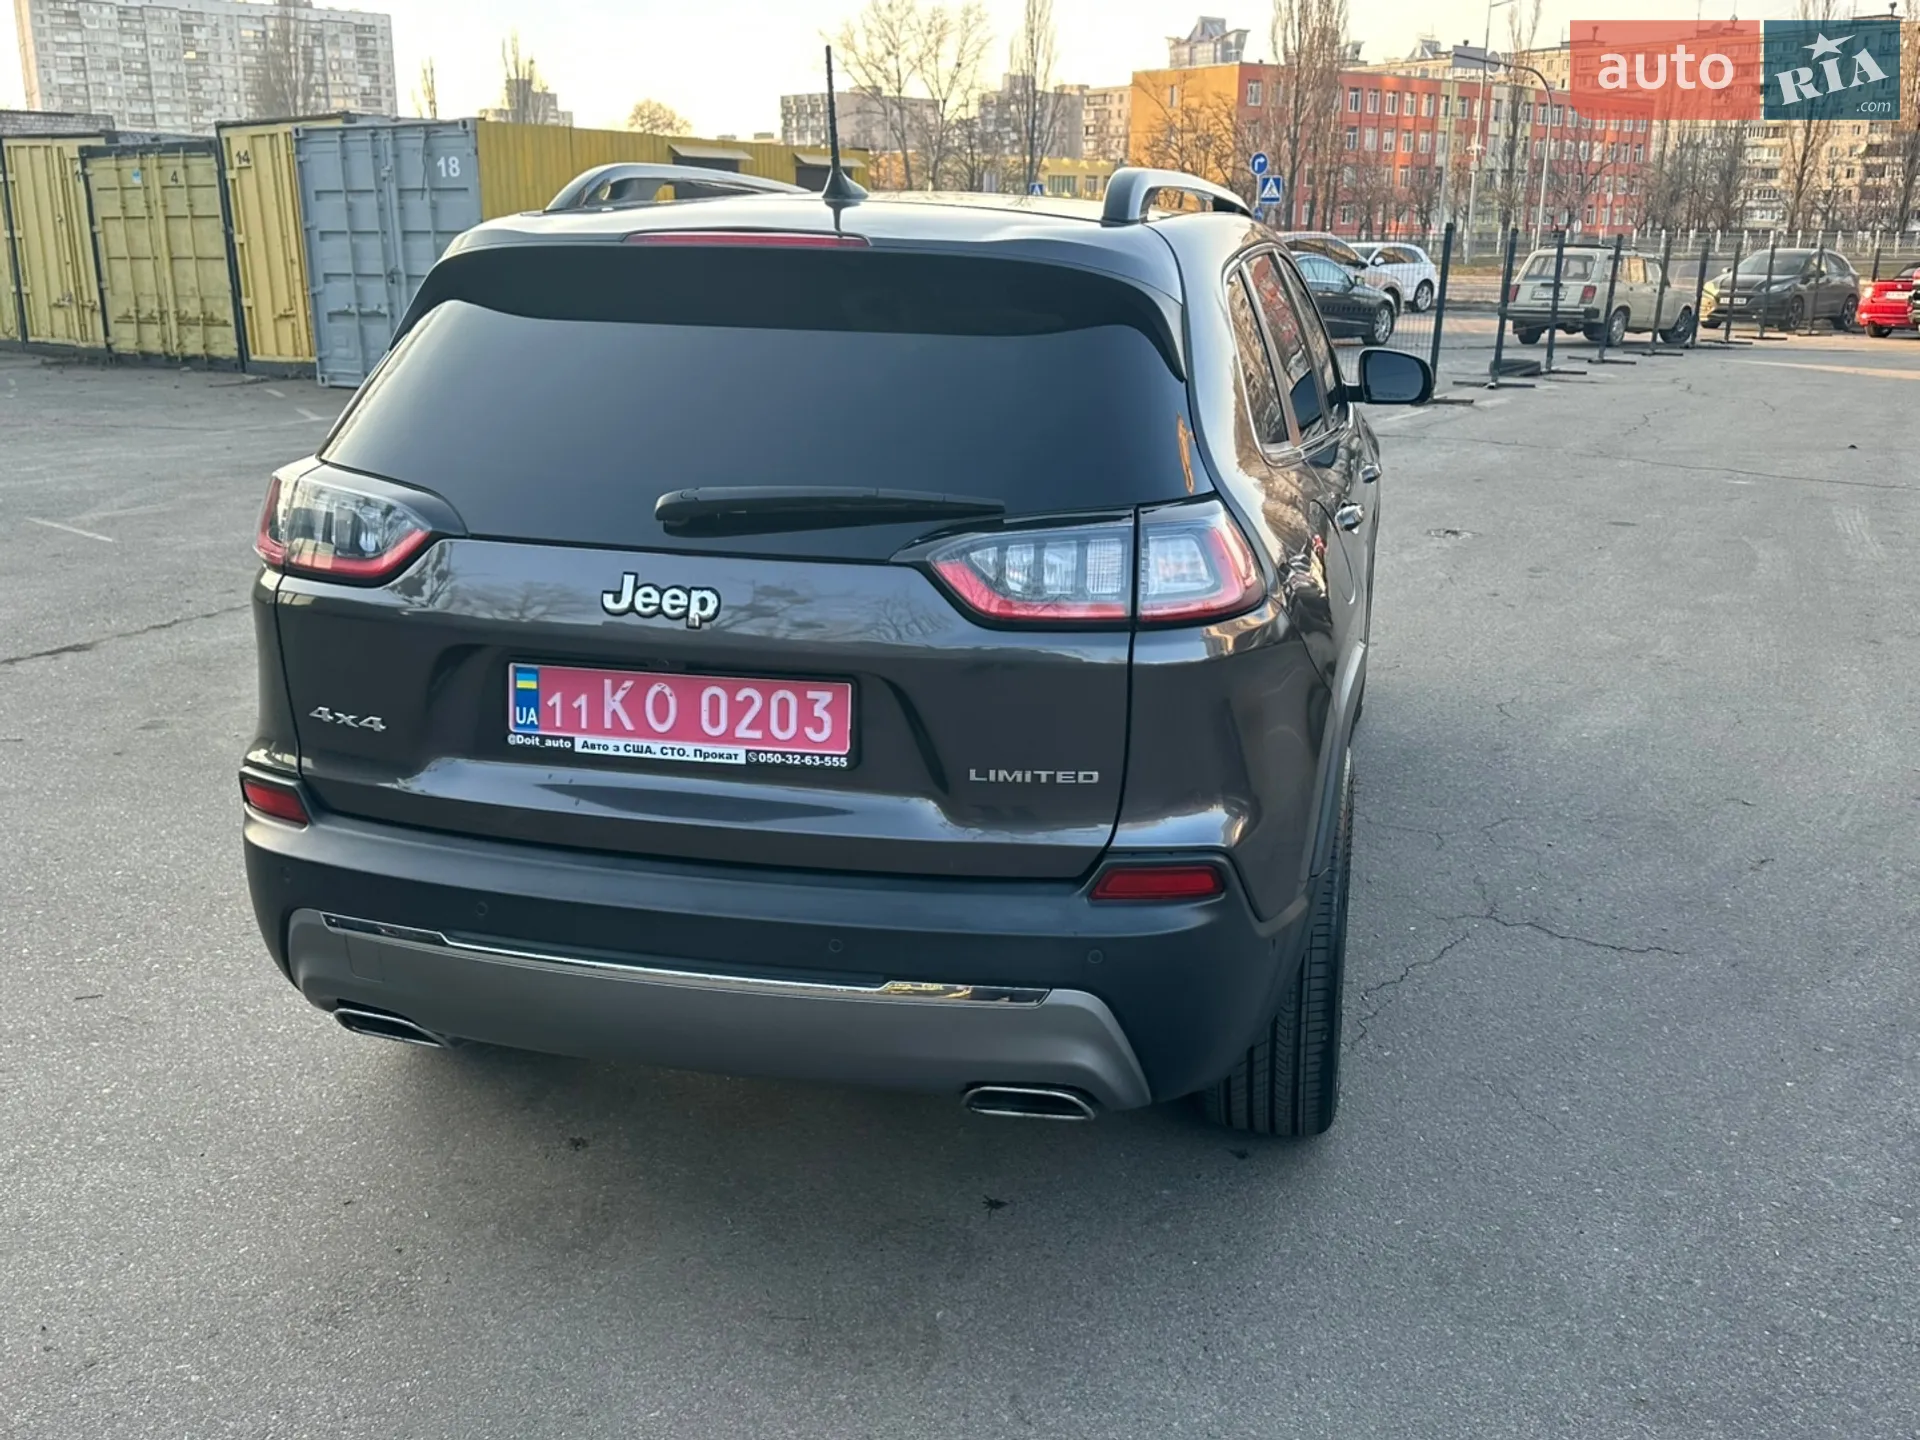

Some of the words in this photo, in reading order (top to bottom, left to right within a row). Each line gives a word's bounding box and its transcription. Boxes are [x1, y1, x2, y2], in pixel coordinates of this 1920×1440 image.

[235, 149, 251, 165] 14
[436, 155, 461, 178] 18
[170, 169, 179, 184] 4
[601, 571, 721, 629] Jeep
[308, 705, 387, 732] 4x4
[515, 706, 539, 726] UA
[700, 685, 834, 744] 0203
[507, 734, 572, 748] @Doit_auto
[581, 740, 609, 752] Авто
[623, 743, 657, 755] США.
[659, 746, 690, 758] СТО.
[693, 748, 739, 761] Прокат
[758, 753, 848, 768] 050-32-63-555
[968, 768, 1100, 784] LIMITED
